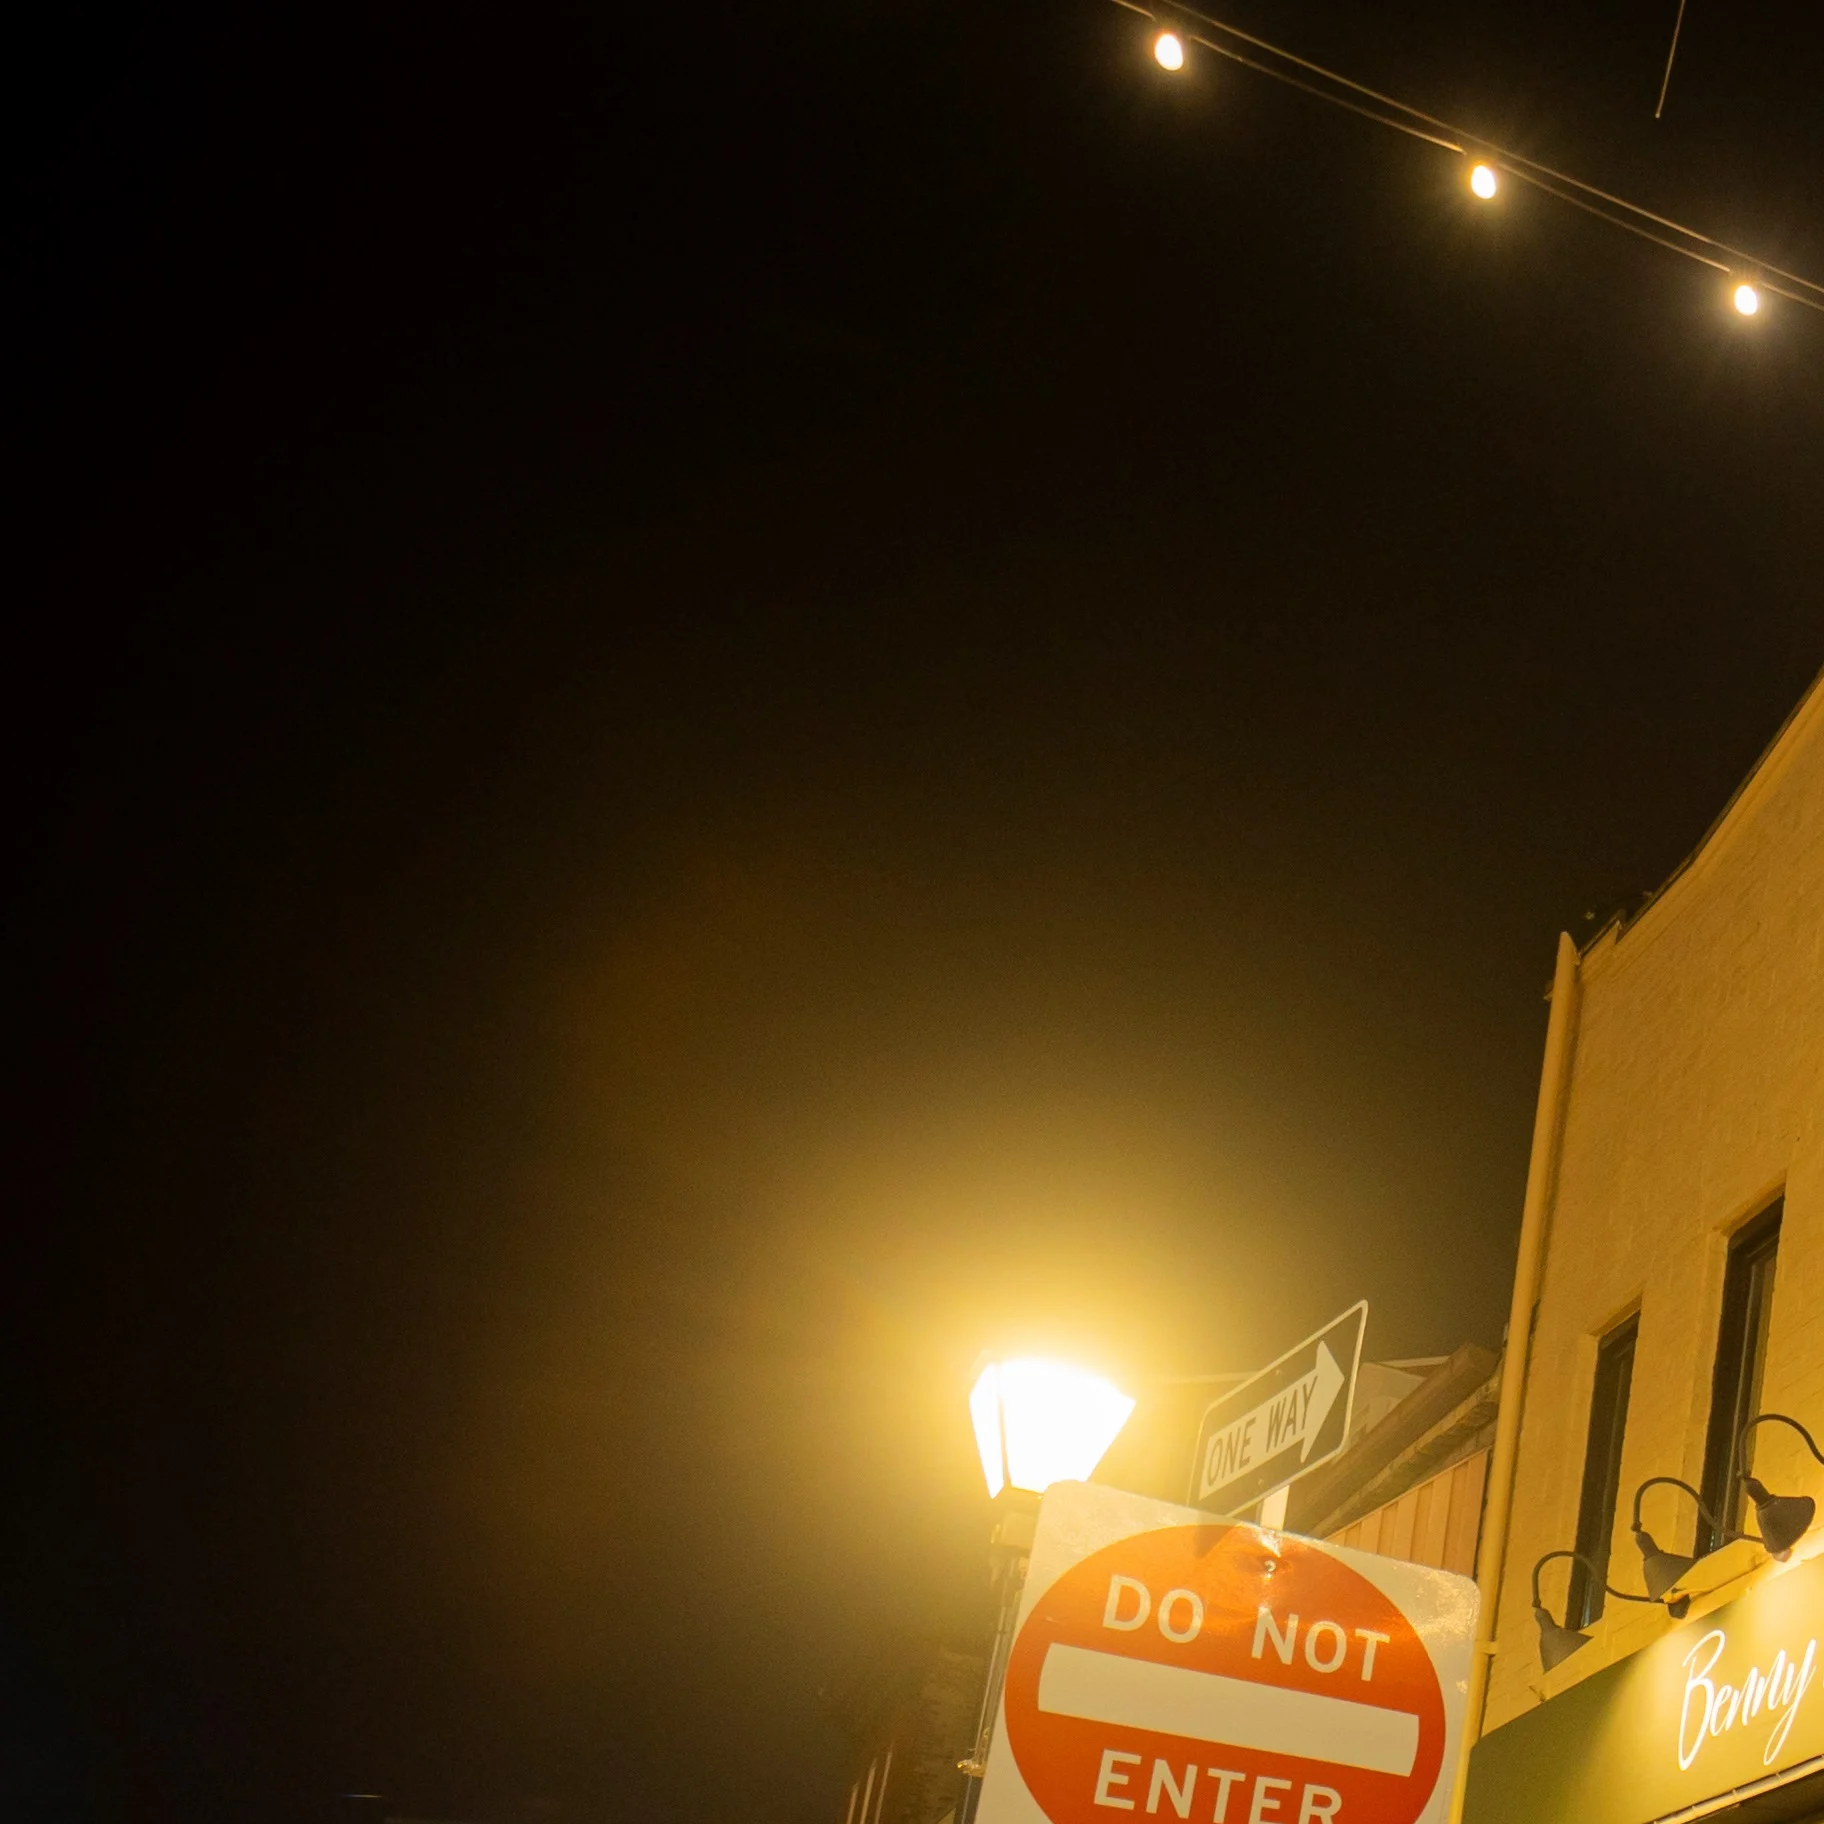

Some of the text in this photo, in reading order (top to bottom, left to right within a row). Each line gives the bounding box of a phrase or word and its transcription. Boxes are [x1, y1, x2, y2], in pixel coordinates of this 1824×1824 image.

[1207, 1375, 1317, 1486] ONE WAY
[1102, 1574, 1391, 1682] DO NOT
